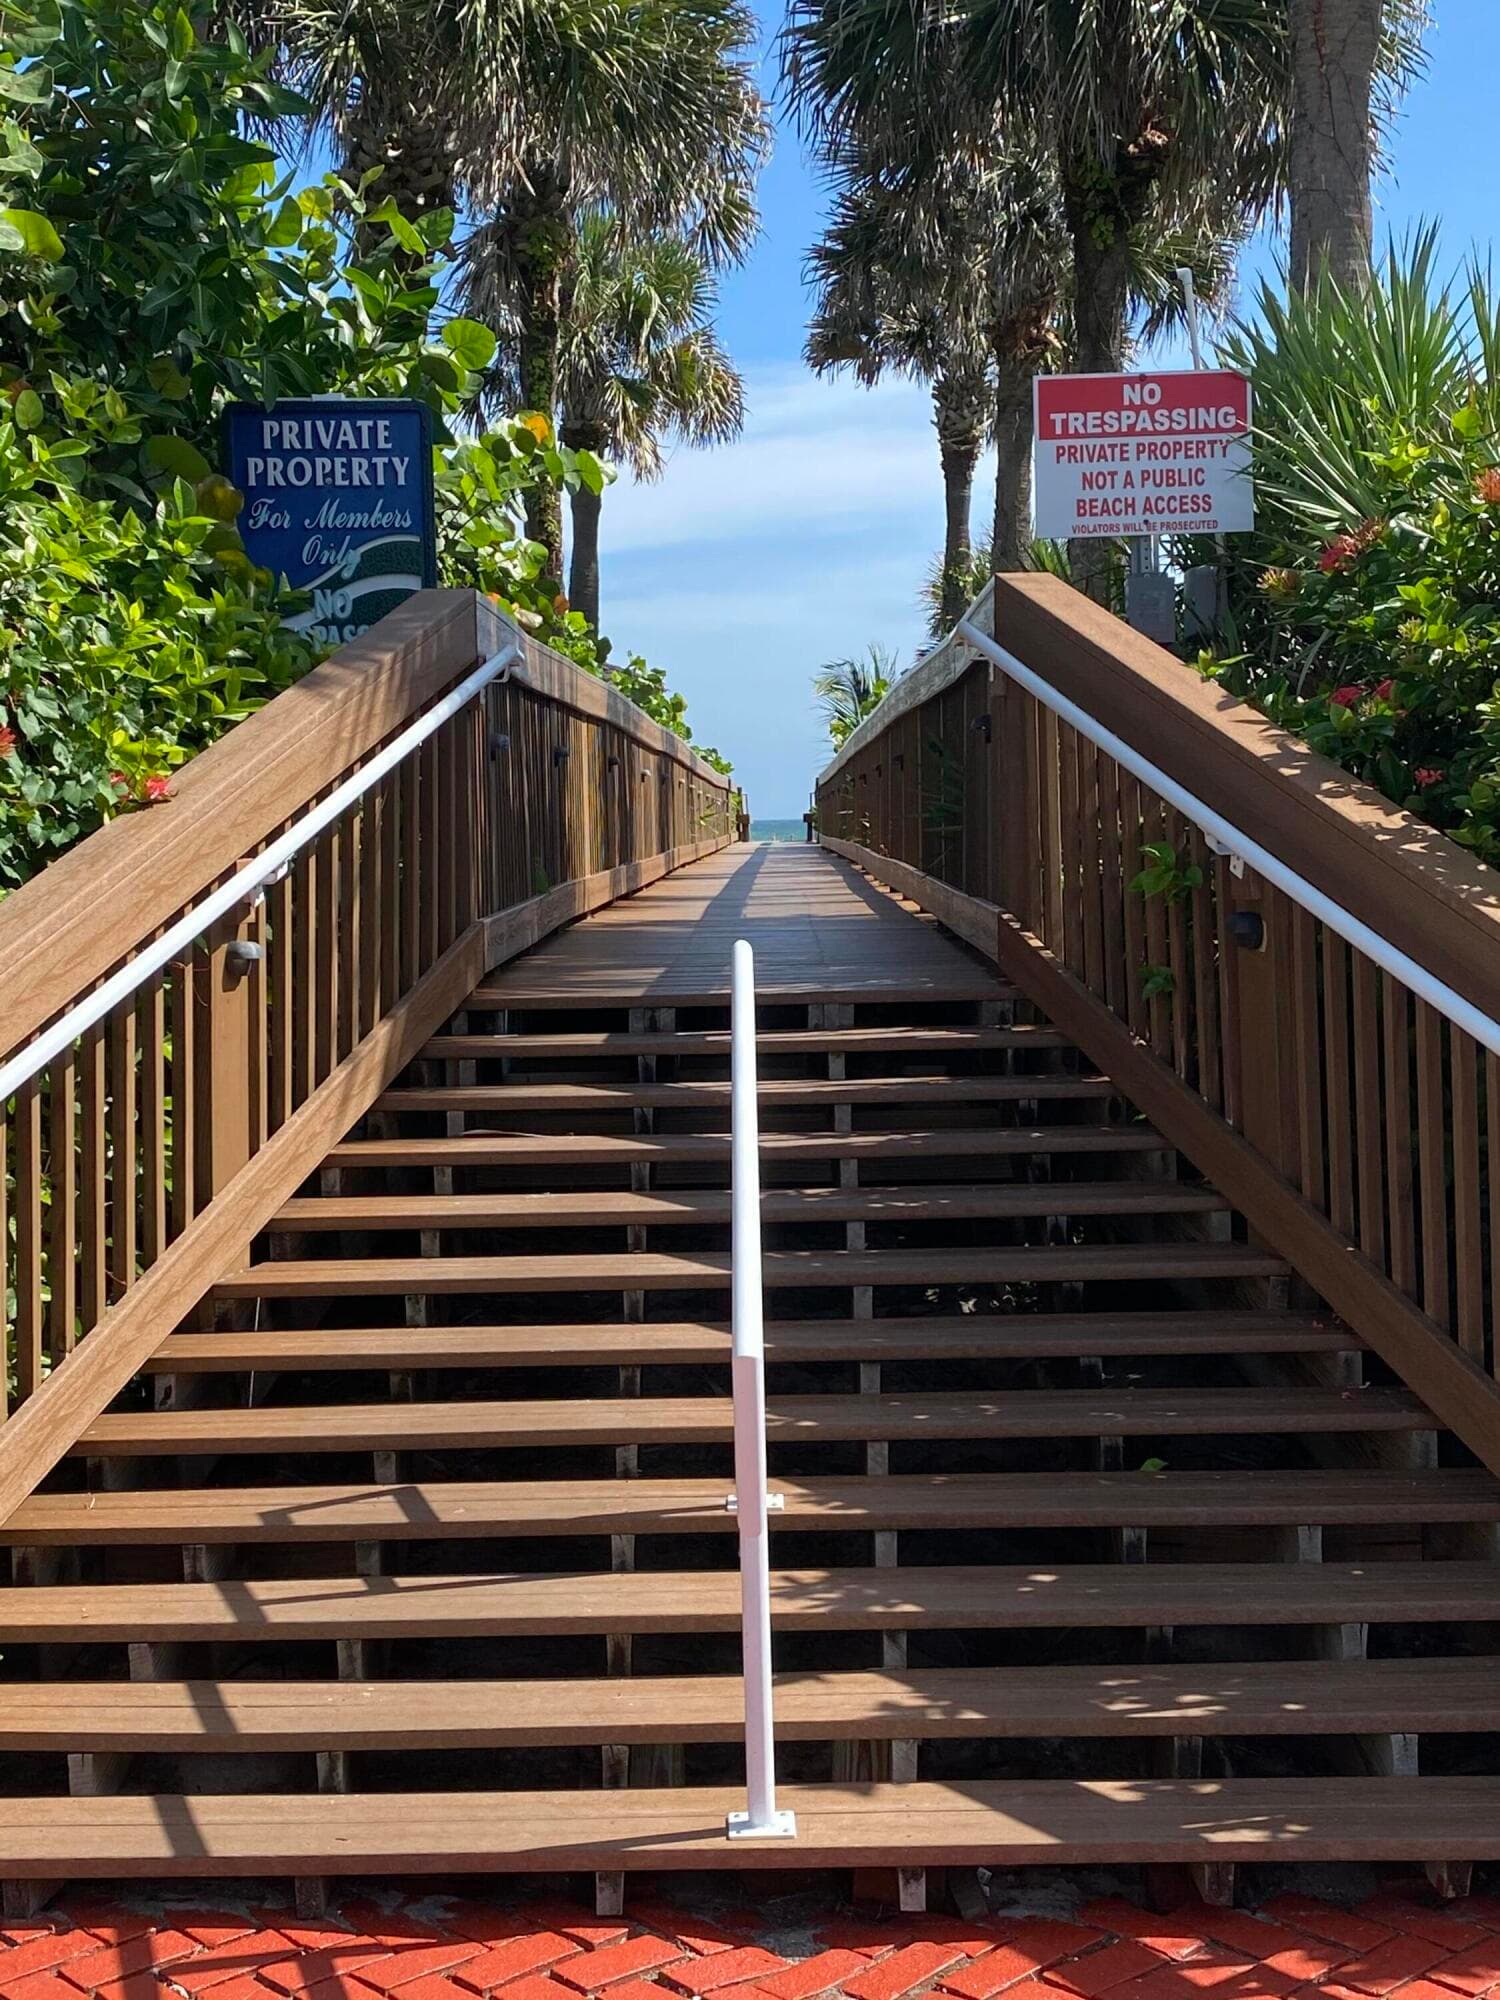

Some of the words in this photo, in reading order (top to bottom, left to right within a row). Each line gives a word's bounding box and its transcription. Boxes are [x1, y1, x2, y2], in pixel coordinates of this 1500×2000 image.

[1123, 382, 1161, 406] NO
[262, 420, 392, 449] PRIVATE
[1050, 406, 1237, 435] TRESPASSING
[1055, 442, 1130, 464] PRIVATE
[1136, 439, 1231, 462] PROPERTY
[247, 457, 410, 486] PROPERTY
[1082, 470, 1118, 491] NOT
[1123, 469, 1135, 489] A
[1141, 467, 1206, 488] PUBLIC
[248, 498, 292, 529] For
[304, 497, 412, 529] Members
[1076, 496, 1136, 518] BEACH
[1142, 494, 1212, 515] ACCESS
[1071, 523, 1121, 535] VIOLATORS
[1123, 522, 1143, 533] WILL
[1146, 521, 1159, 532] BE
[1160, 520, 1219, 531] PROSECUTED
[302, 534, 362, 580] Only
[312, 588, 353, 620] NO
